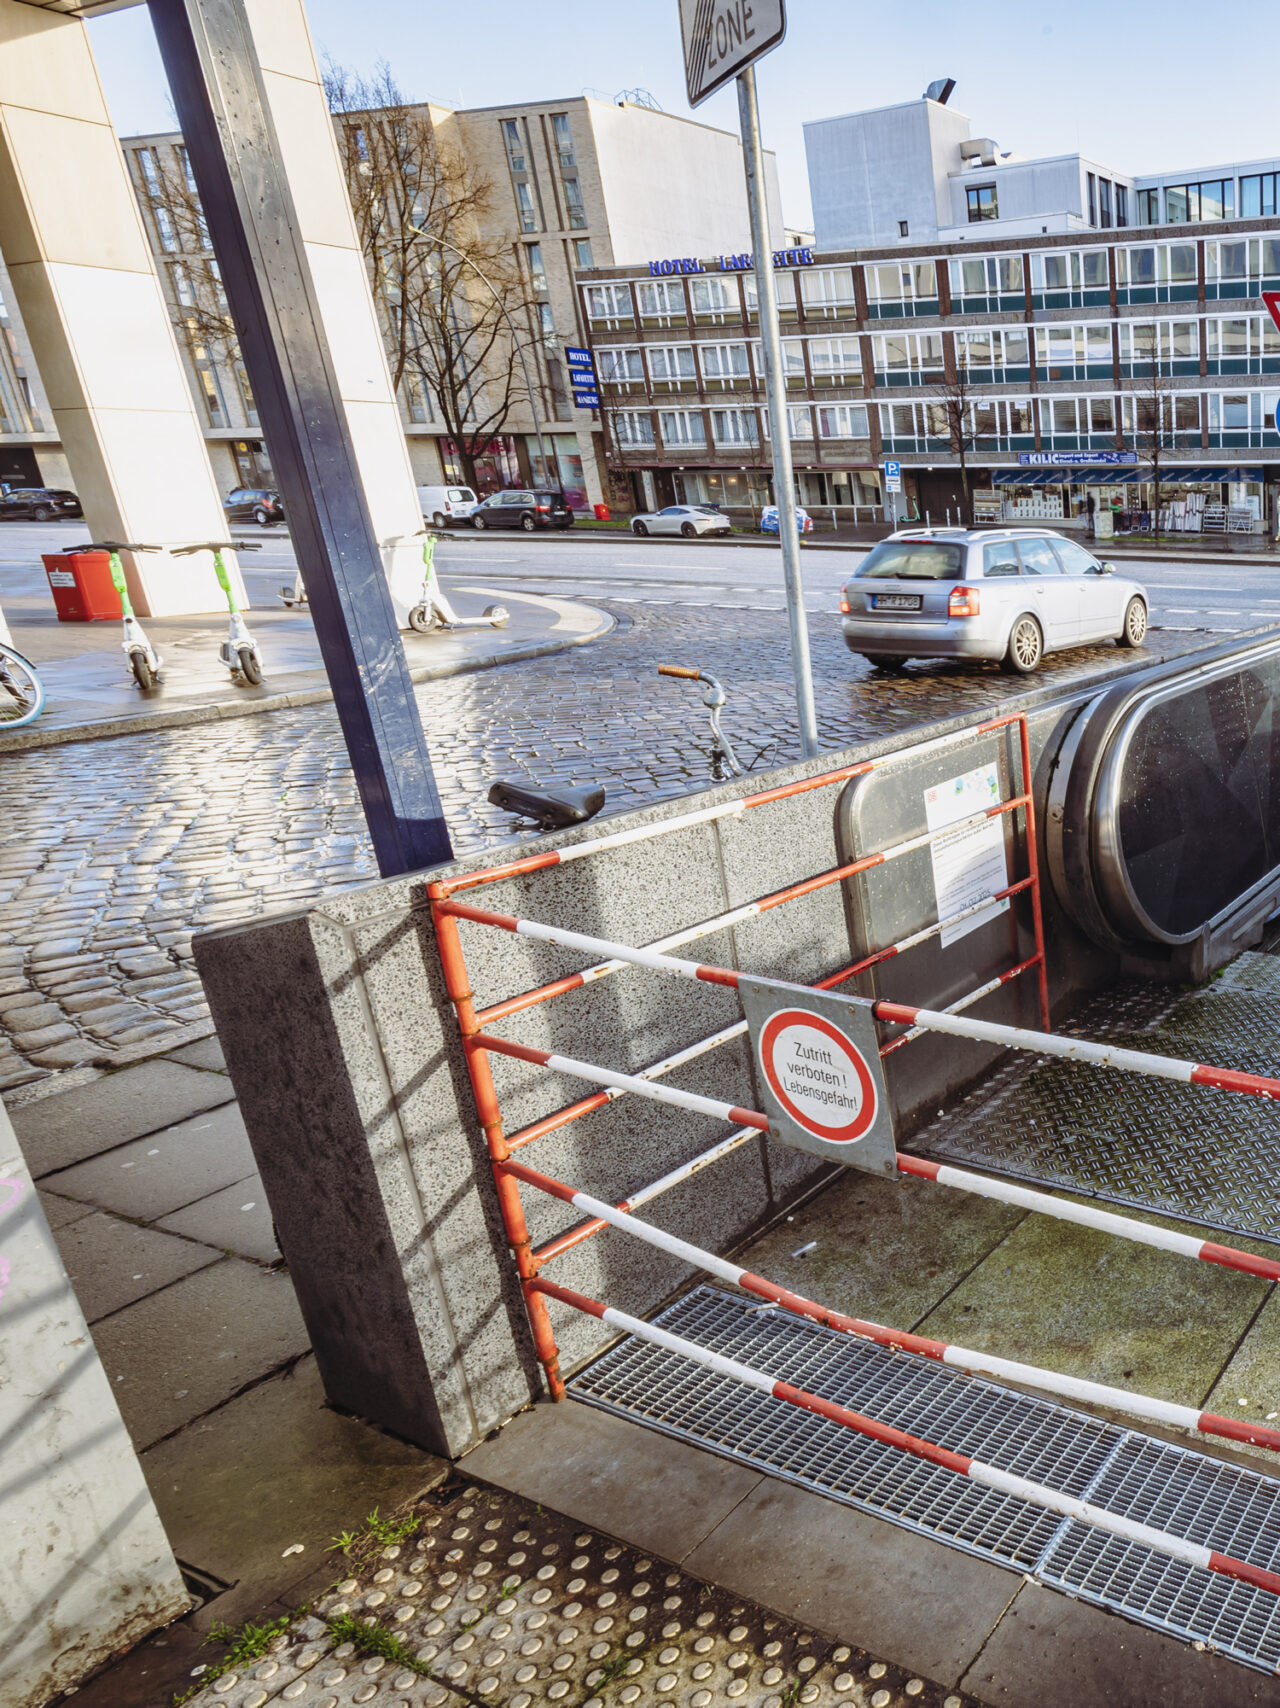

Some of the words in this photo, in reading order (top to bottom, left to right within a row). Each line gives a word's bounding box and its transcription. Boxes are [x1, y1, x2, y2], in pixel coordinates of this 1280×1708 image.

[706, 0, 755, 70] ZONE
[649, 257, 705, 275] HOTEL
[719, 248, 814, 270] LAFETTE
[569, 352, 592, 361] HOTEL
[888, 463, 897, 475] P
[1029, 453, 1059, 464] KILIC
[793, 1041, 833, 1065] Zutritt
[787, 1061, 841, 1087] verboten
[783, 1076, 859, 1111] Lebensgefahr!
